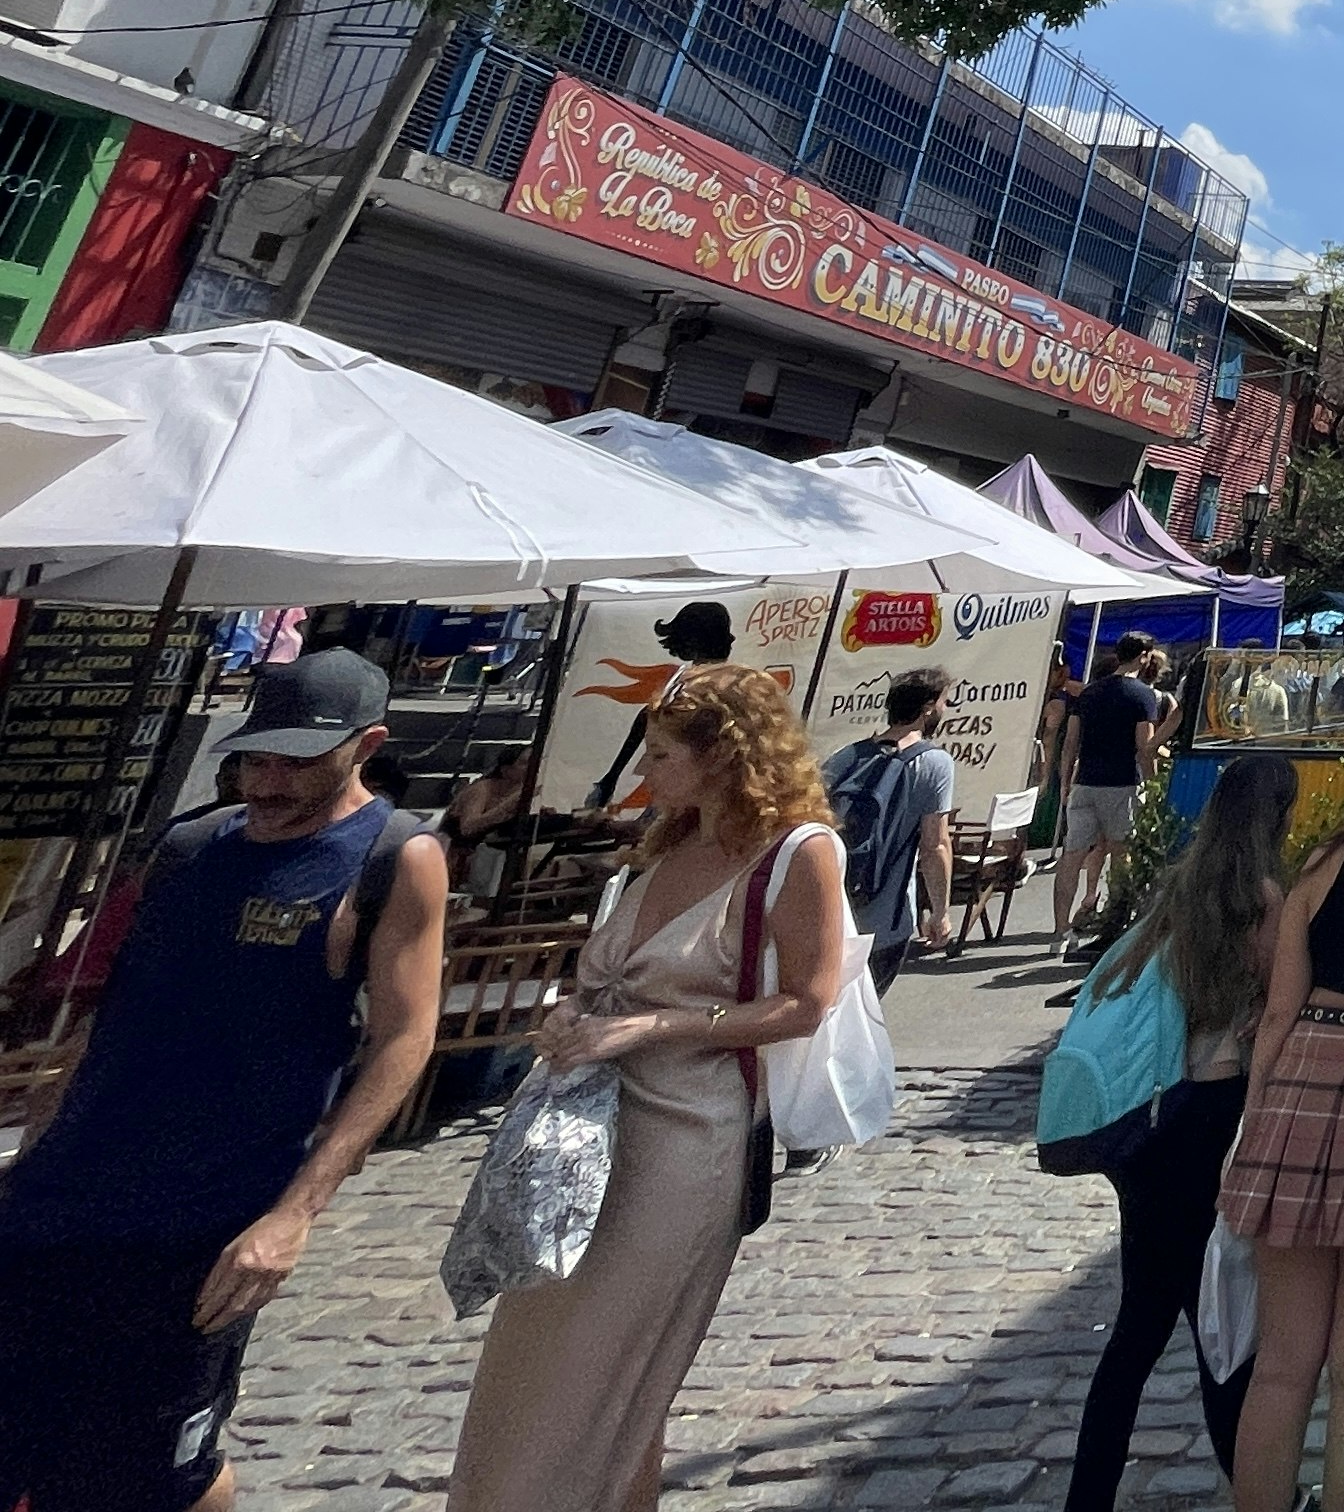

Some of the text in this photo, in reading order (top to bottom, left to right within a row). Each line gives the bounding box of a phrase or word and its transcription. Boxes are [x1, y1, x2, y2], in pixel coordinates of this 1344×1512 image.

[598, 122, 722, 201] República de
[600, 171, 697, 238] La Boca
[962, 268, 1009, 304] PASEO
[815, 244, 1090, 392] CAMINITO 830
[745, 594, 832, 633] APEROL
[865, 616, 927, 633] ARTOIS
[868, 600, 925, 616] STELLA
[953, 593, 1050, 642] Quilmes
[758, 617, 821, 647] SPRITZ
[829, 692, 886, 718] PATAG
[945, 679, 1028, 713] Corona
[932, 715, 993, 739] VEZAS
[942, 742, 997, 769] DAS!
